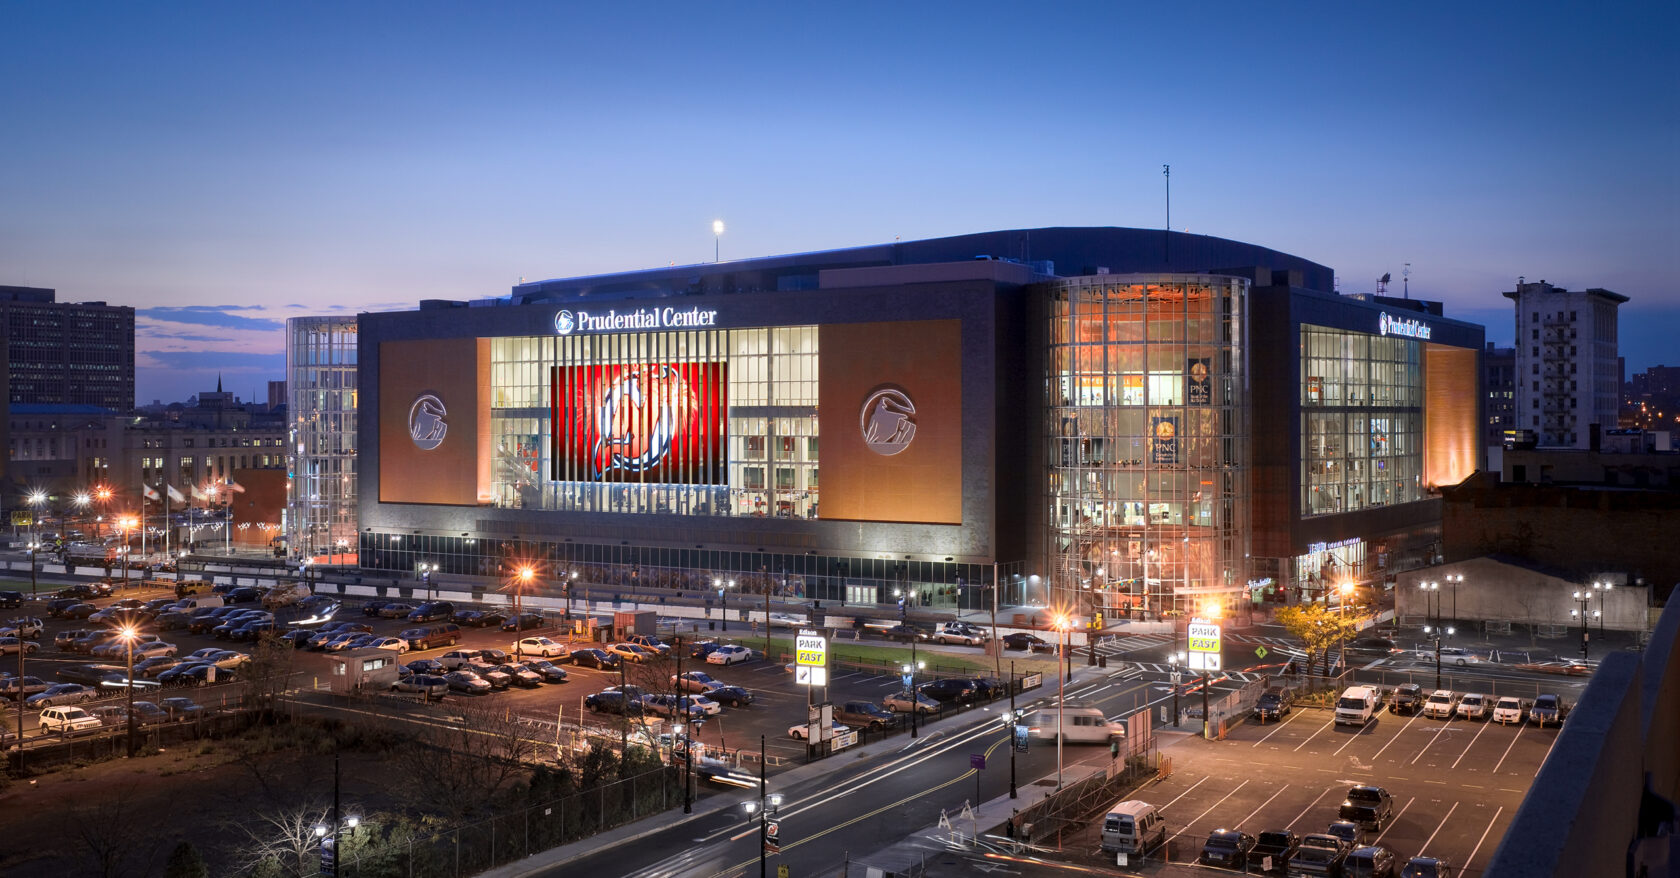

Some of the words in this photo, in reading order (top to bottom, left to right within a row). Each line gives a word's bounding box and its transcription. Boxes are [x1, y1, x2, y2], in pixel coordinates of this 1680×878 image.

[577, 308, 660, 330] Prudential
[662, 306, 717, 326] Center
[1190, 384, 1208, 394] PNC
[1155, 443, 1176, 452] PNC
[1191, 628, 1217, 636] PARK
[799, 640, 822, 649] PARK
[1192, 640, 1217, 648] FAST
[799, 652, 822, 662] FAST
